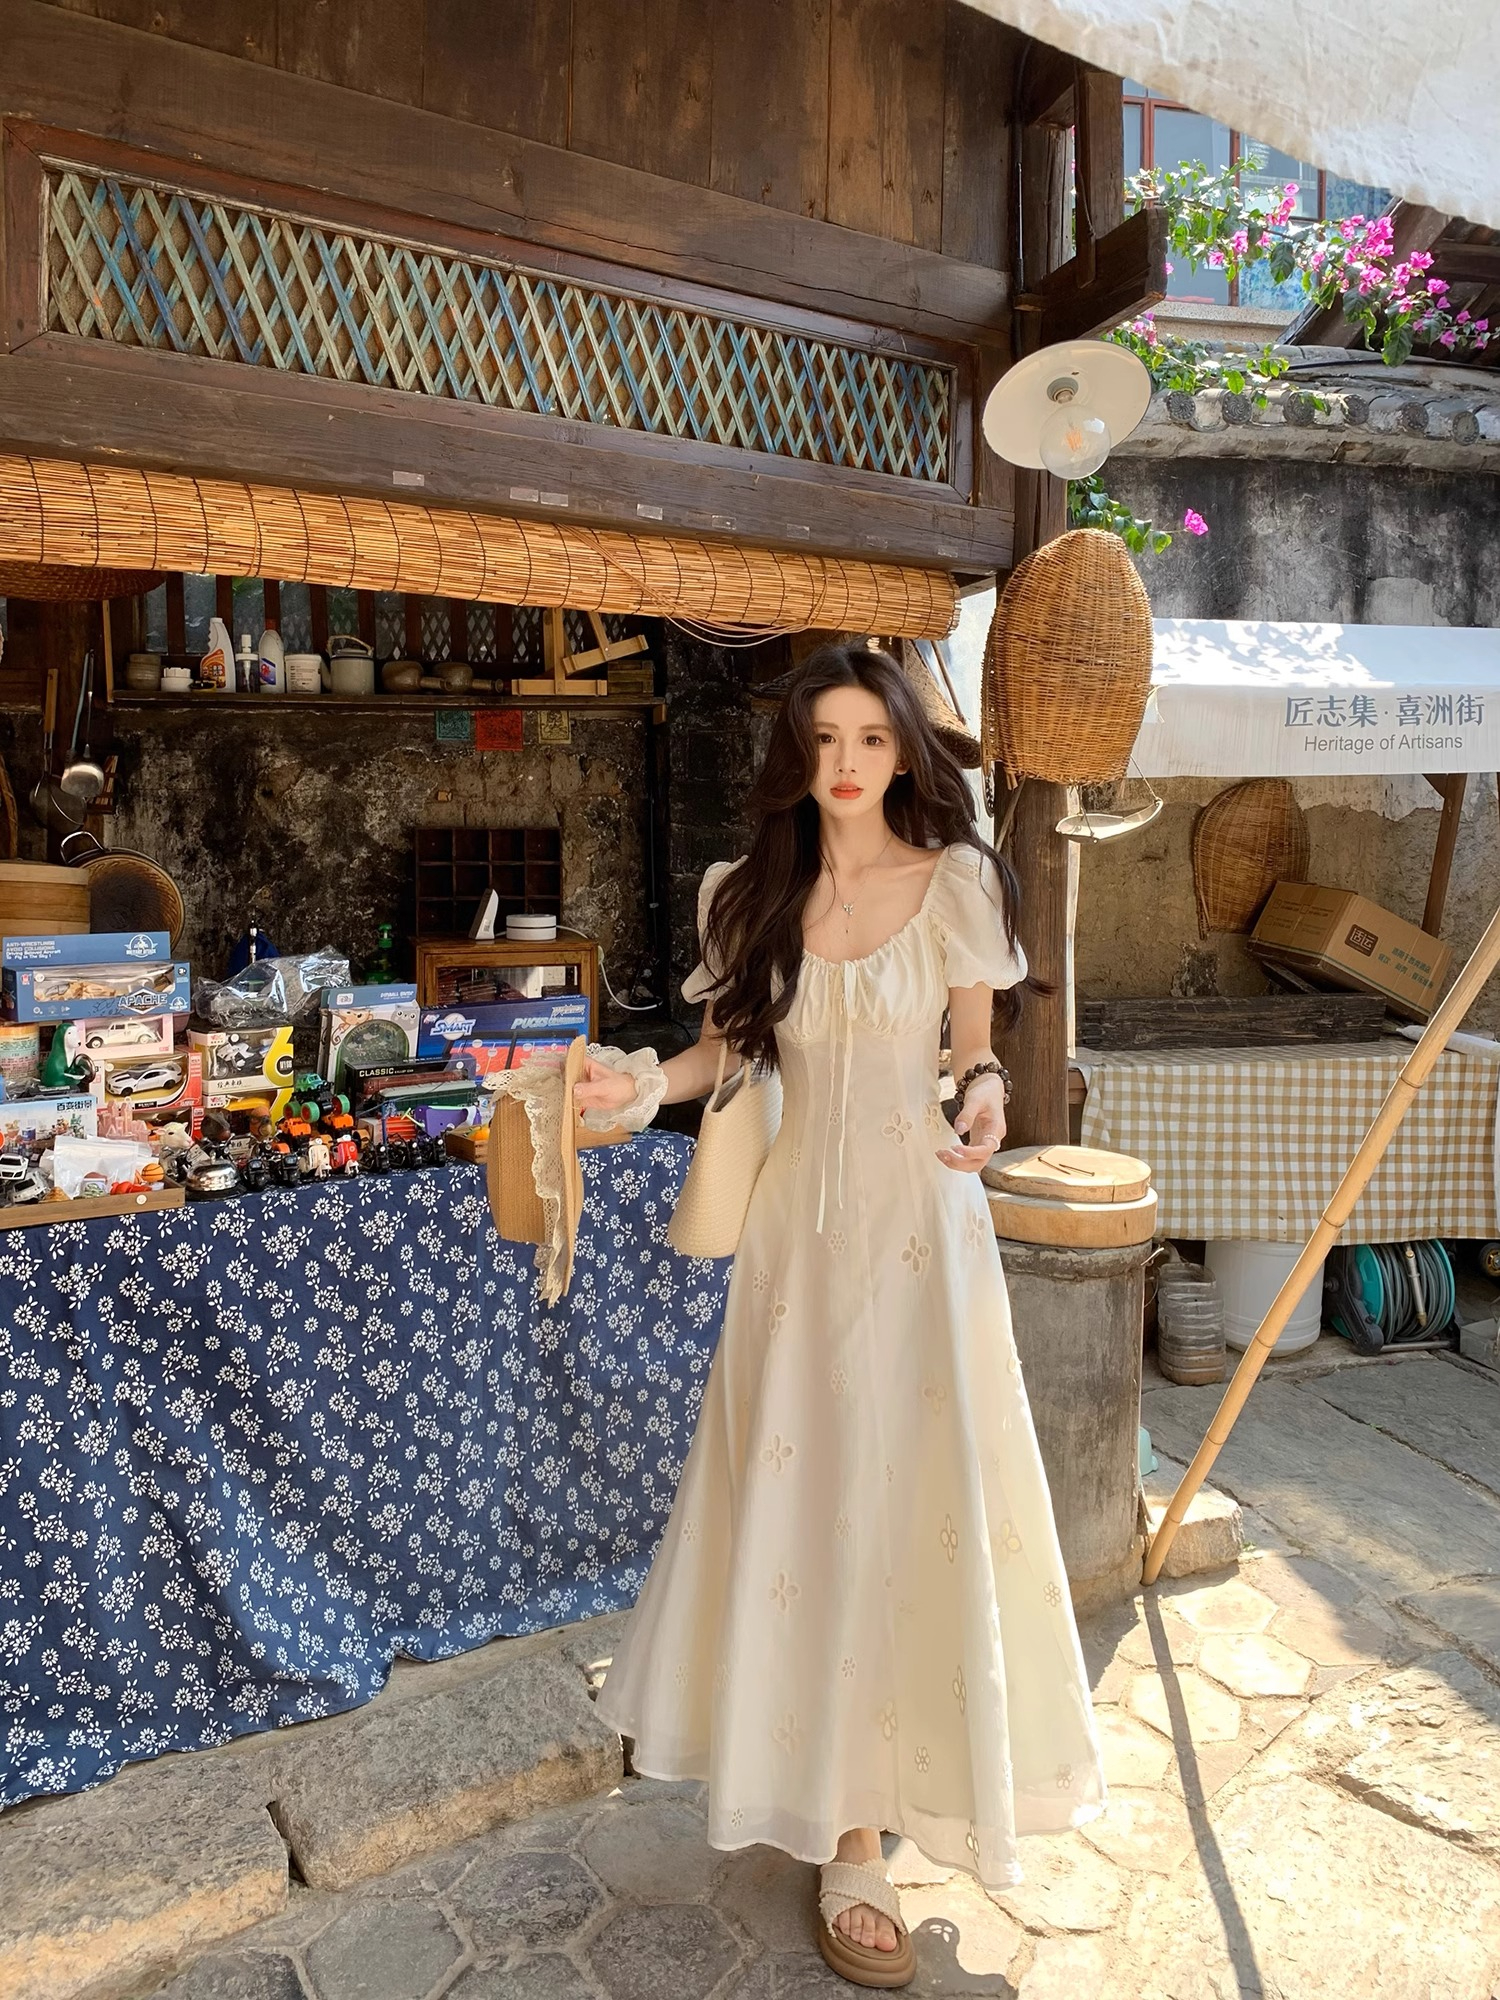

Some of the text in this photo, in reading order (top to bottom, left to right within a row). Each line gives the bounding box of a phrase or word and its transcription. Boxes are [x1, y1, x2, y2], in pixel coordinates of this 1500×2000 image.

[1284, 693, 1485, 729] 匠志集·喜洲街
[1304, 734, 1463, 754] Heritage of Artisans
[118, 993, 168, 1006] APACHE
[429, 1018, 476, 1036] SMART
[510, 1017, 549, 1030] PUCKS
[359, 1067, 395, 1077] CLASSIC
